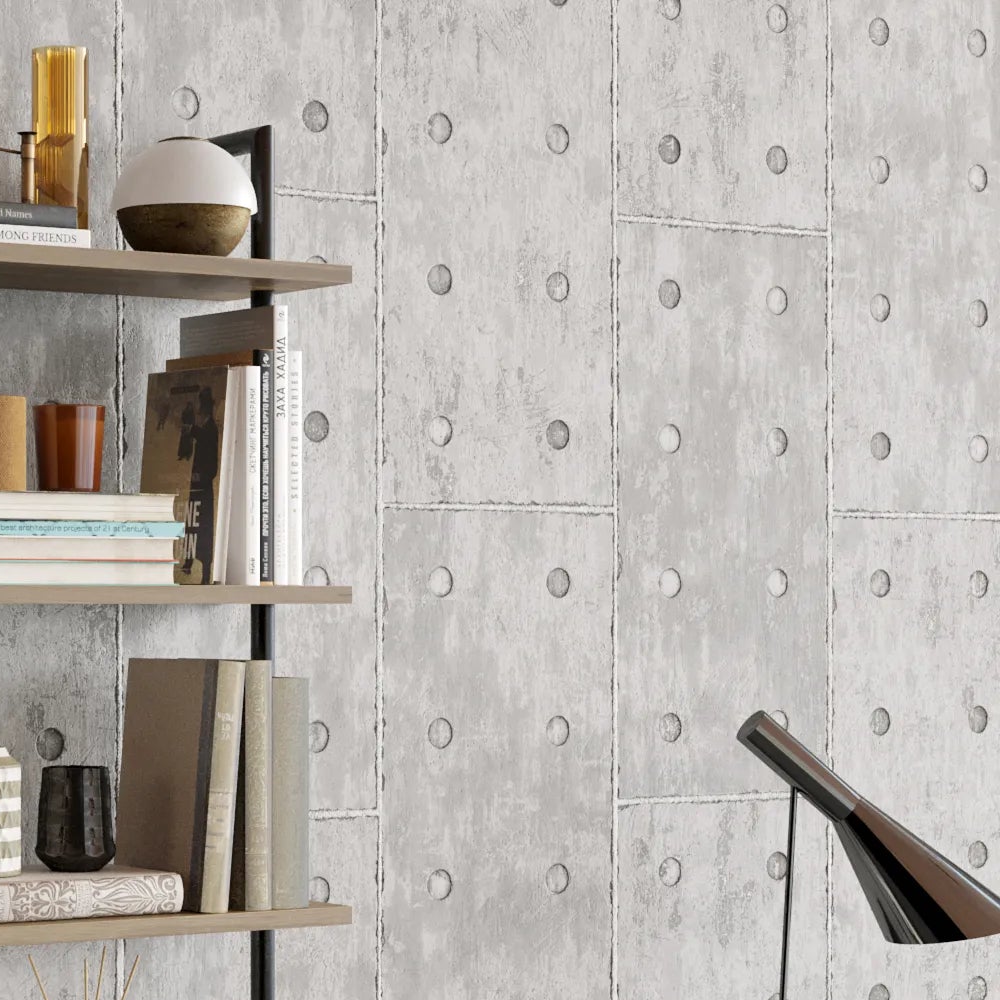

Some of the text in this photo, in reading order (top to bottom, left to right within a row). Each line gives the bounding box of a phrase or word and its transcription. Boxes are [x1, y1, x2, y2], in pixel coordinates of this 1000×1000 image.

[5, 208, 33, 220] Names
[31, 232, 78, 245] FRIENDS
[262, 371, 270, 403] РИСОВАТЬ
[276, 337, 287, 419] ЗАХА ХАДИД
[262, 403, 270, 423] КРУТО
[249, 388, 257, 474] СКЕТЧИНГ МАРКЕРАМИ
[262, 424, 270, 459] НАУЧИТЬСЯ
[290, 371, 299, 500] SELECTED STORIES
[262, 460, 270, 485] ХОЧЕШЬ
[262, 485, 270, 500] ЕСЛИ
[0, 523, 17, 532] best
[63, 524, 92, 535] projects
[93, 524, 101, 533] of
[102, 524, 111, 533] 21
[121, 524, 150, 535] Century
[262, 514, 270, 537] ПРОЧТИ
